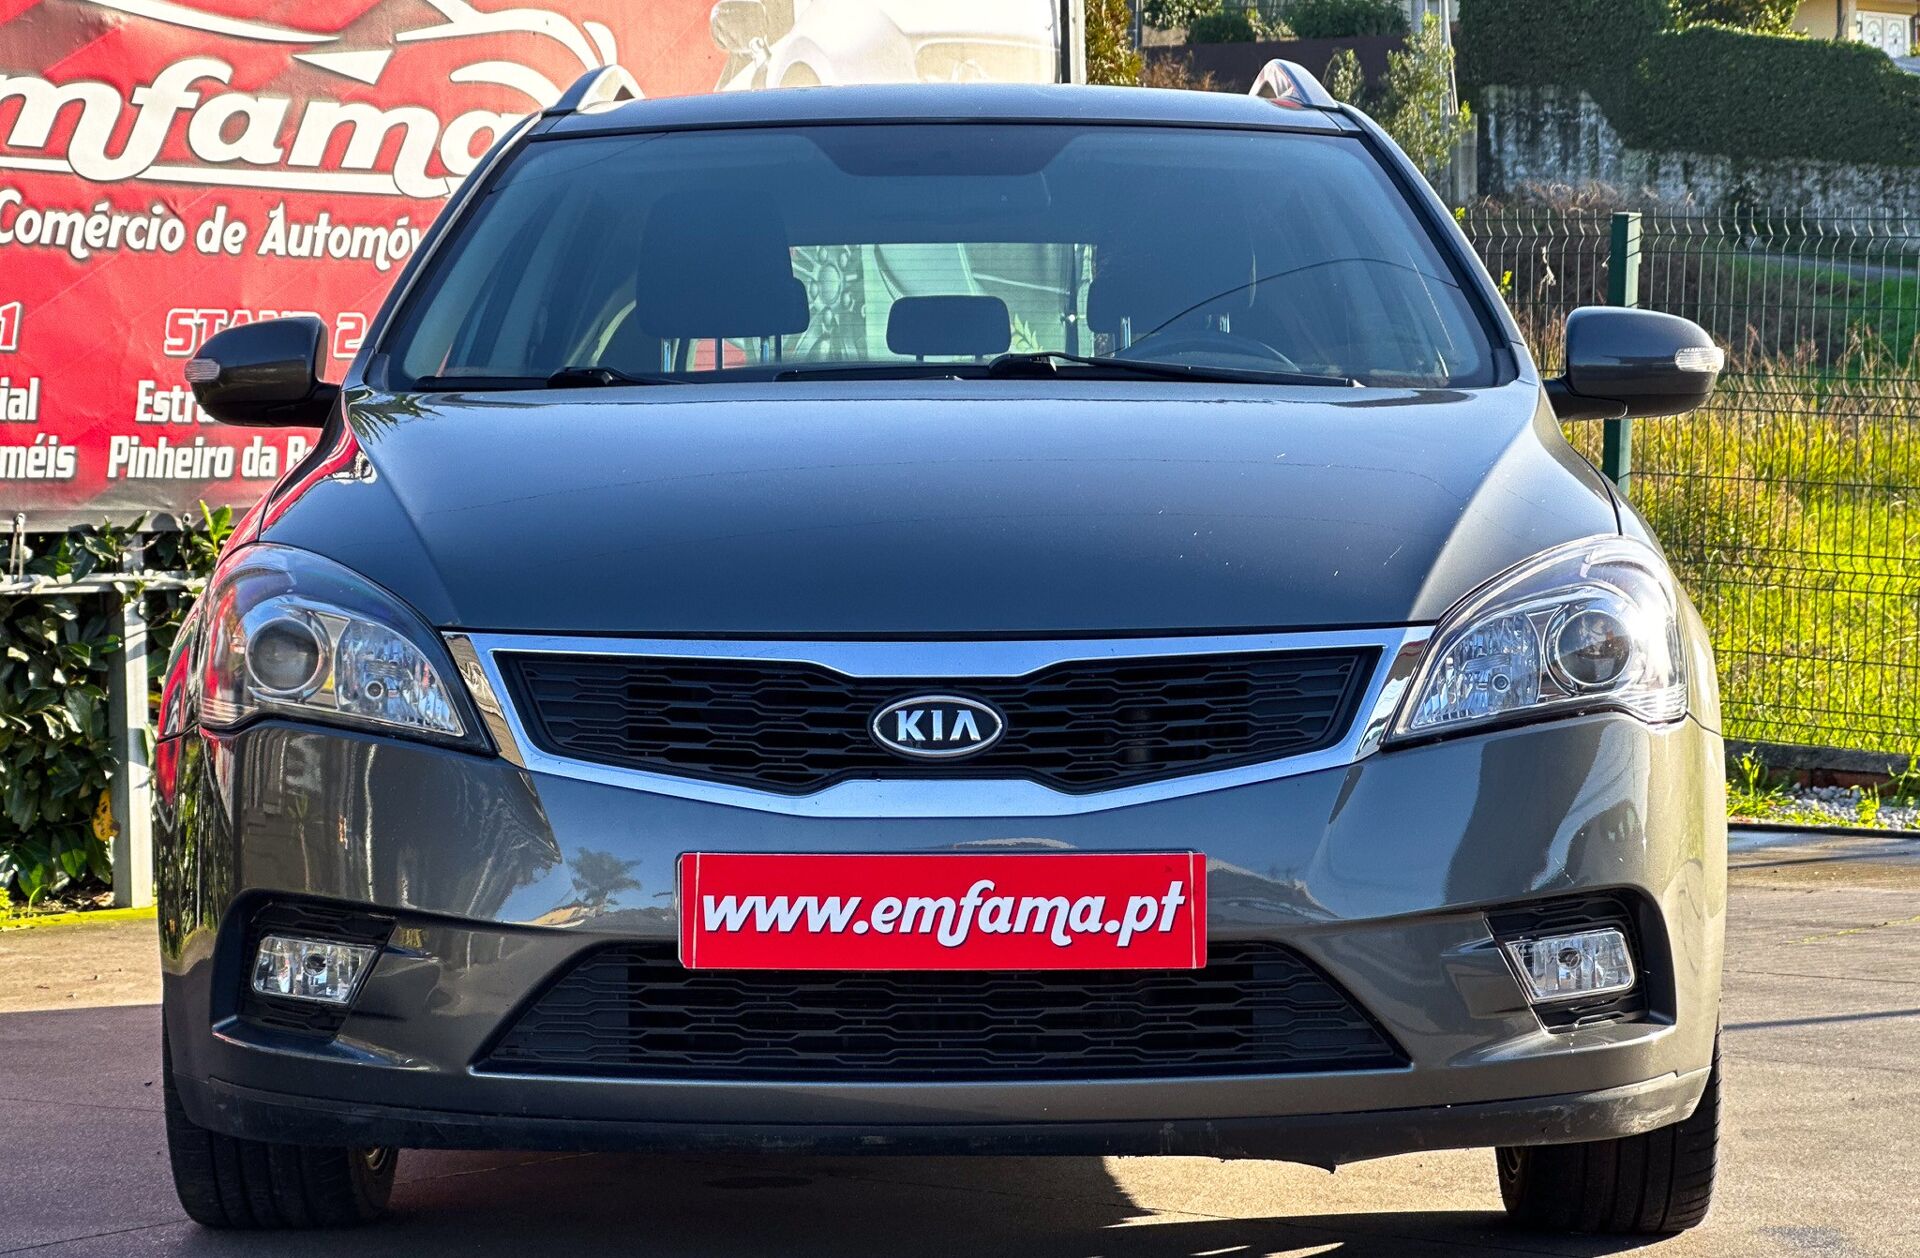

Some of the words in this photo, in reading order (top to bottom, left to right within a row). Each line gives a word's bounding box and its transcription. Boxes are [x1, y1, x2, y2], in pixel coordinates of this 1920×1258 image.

[0, 188, 186, 259] Comércio
[196, 205, 247, 255] de
[333, 312, 367, 358] 2
[107, 435, 235, 478] Pinheiro
[241, 436, 278, 477] da
[896, 710, 981, 741] KIA
[703, 879, 1186, 947] www.emfama.pt
